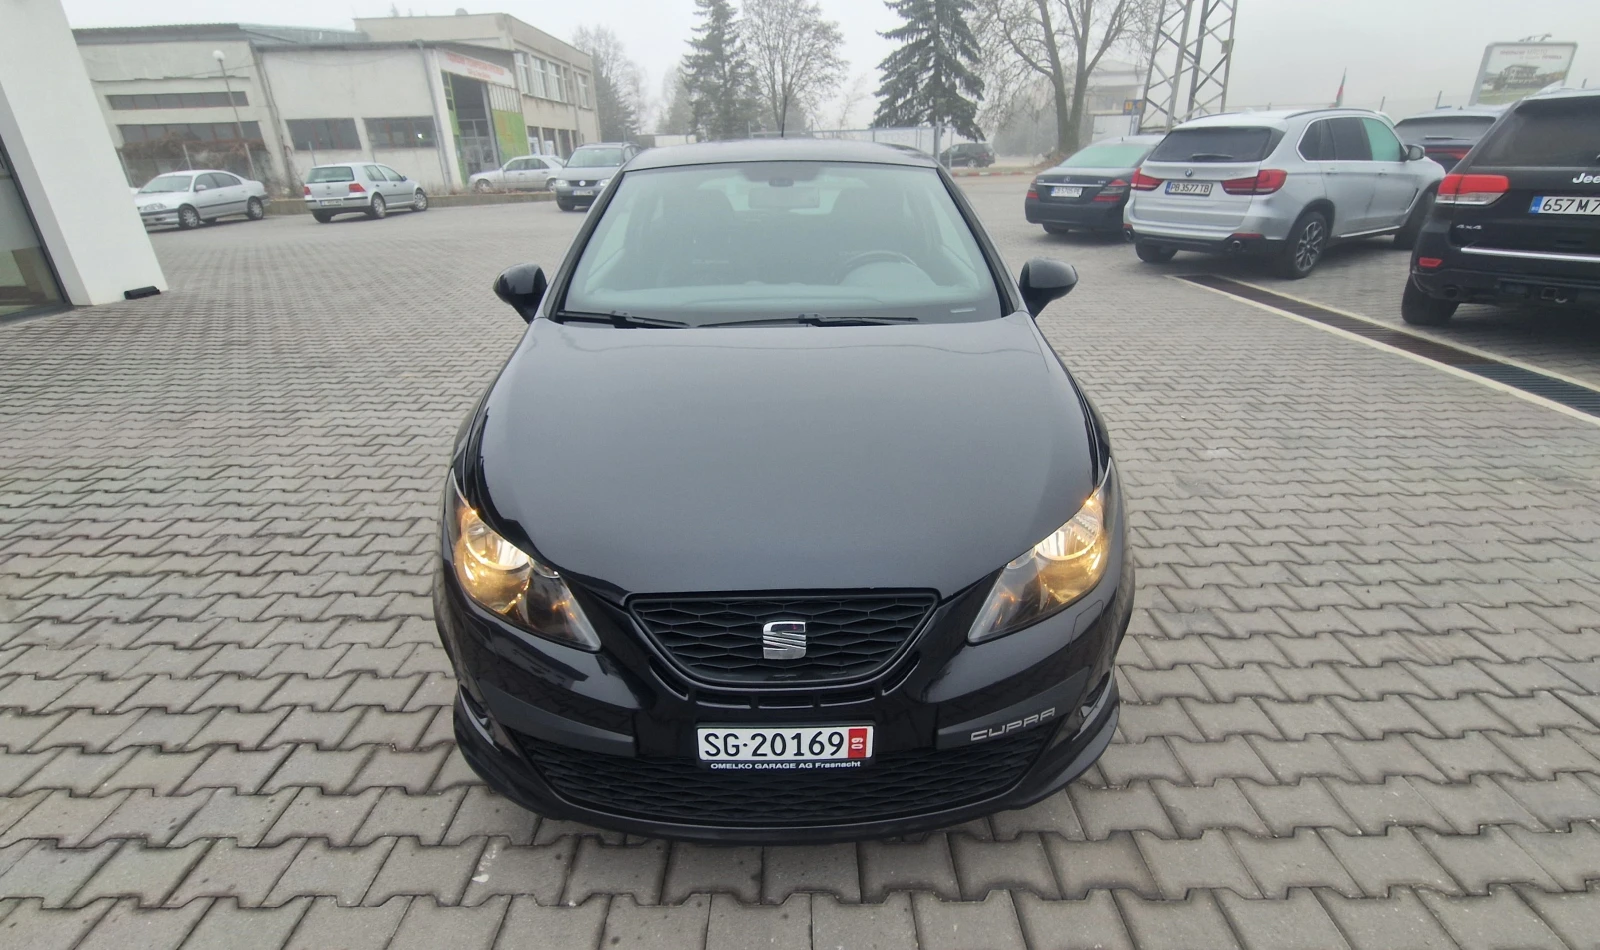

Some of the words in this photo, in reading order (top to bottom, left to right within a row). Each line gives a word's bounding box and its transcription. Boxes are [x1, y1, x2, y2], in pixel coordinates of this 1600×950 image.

[970, 706, 1056, 742] CUPRA
[710, 762, 753, 770] OMELKO
[754, 762, 796, 770] GARAGE
[815, 760, 861, 769] Frasnacht
